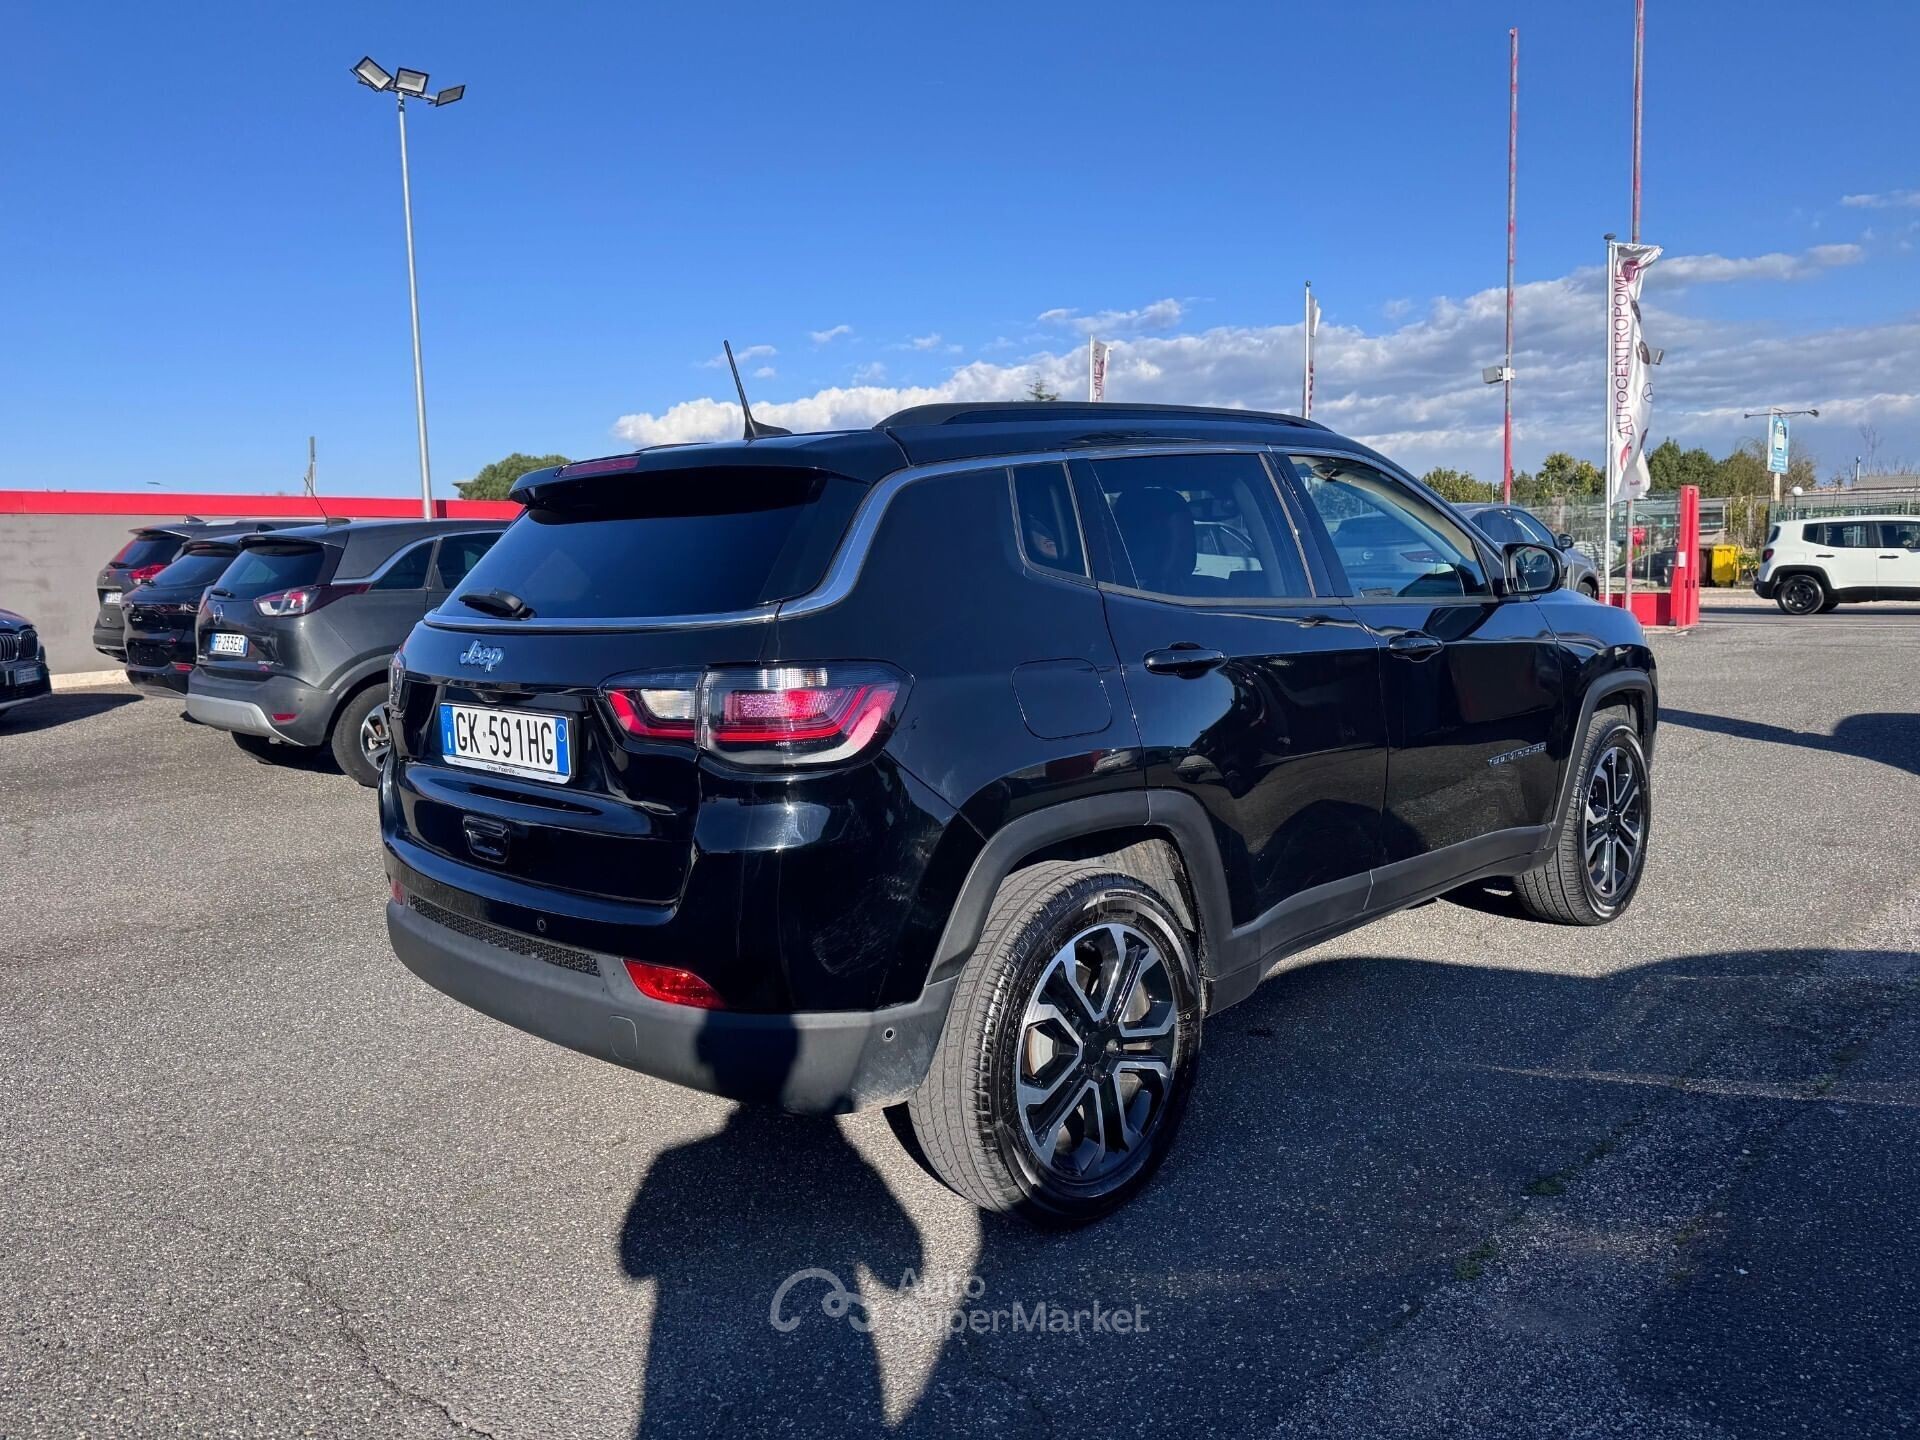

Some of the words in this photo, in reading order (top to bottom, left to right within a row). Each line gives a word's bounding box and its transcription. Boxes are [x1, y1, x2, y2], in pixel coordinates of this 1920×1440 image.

[459, 639, 504, 672] Jeep
[455, 712, 480, 754] GK
[489, 715, 554, 765] 591HG
[1487, 741, 1547, 768] COMPASS
